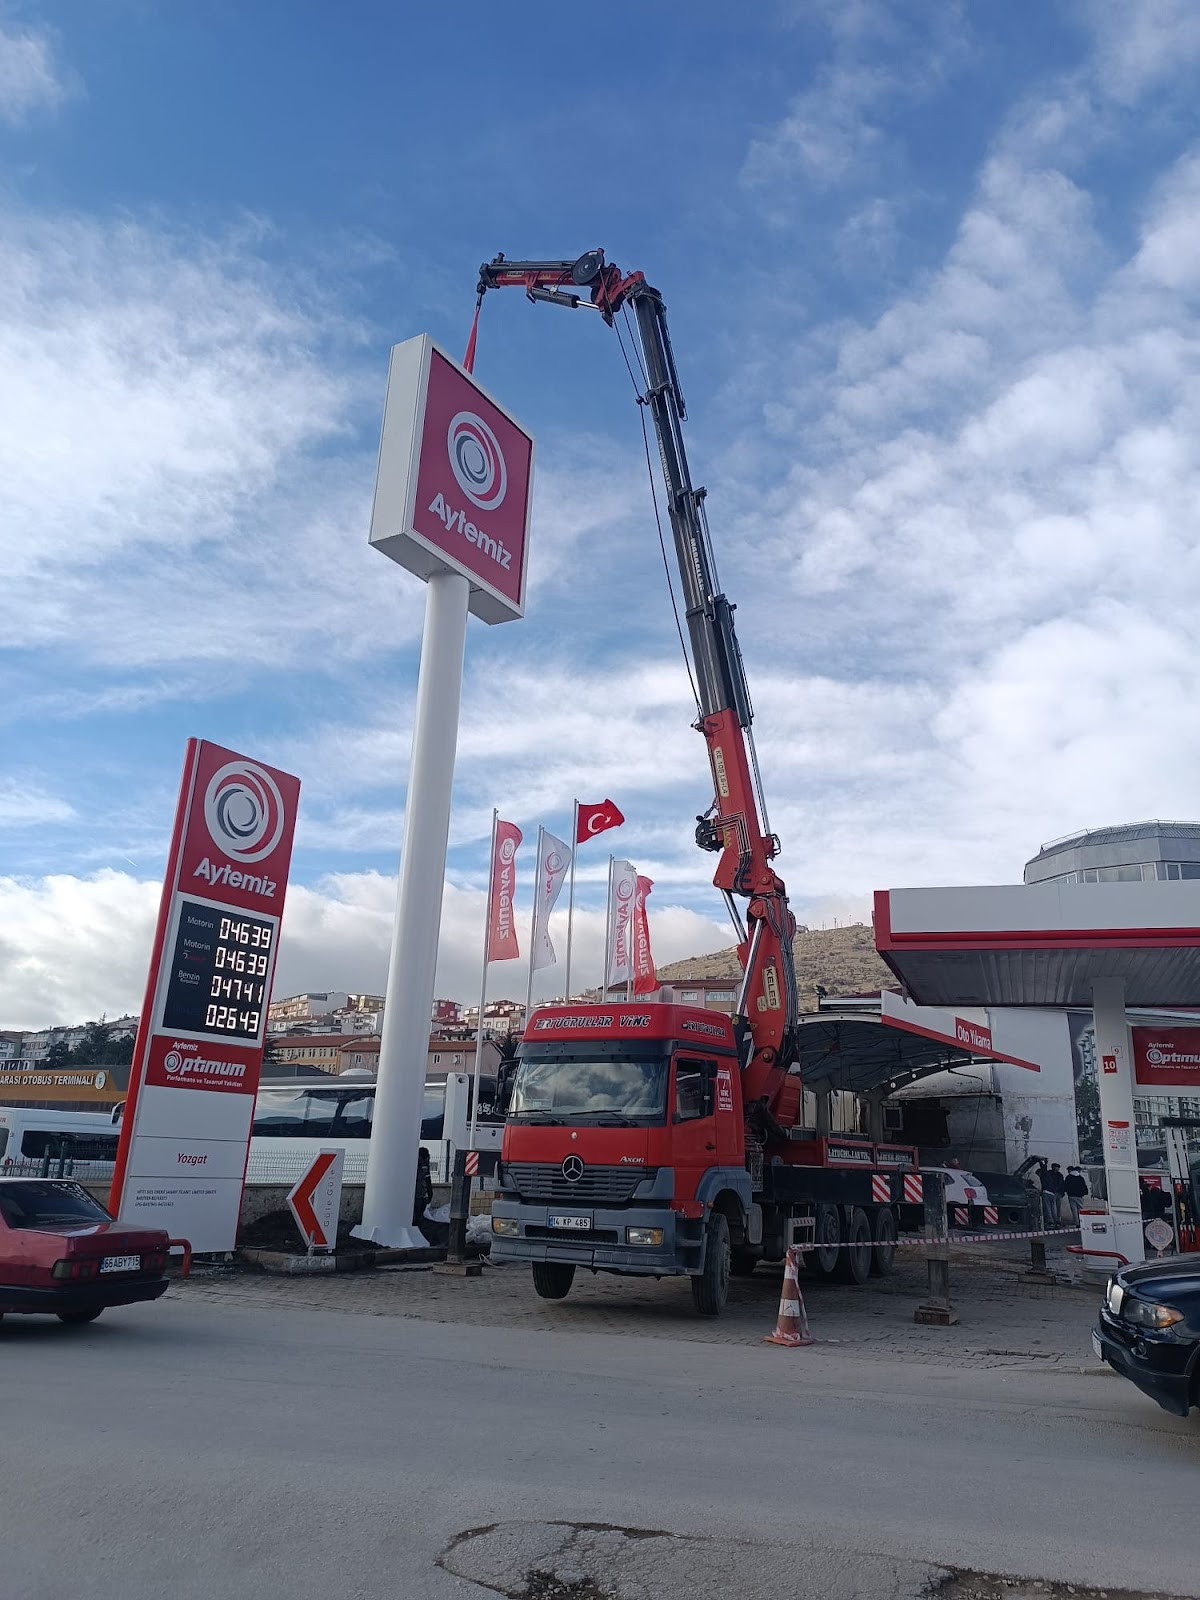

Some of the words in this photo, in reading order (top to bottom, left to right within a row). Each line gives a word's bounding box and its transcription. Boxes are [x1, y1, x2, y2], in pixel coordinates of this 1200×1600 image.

[428, 492, 512, 570] Aytemiz
[193, 857, 277, 898] Aytemiz
[187, 916, 214, 929] Motorin
[219, 918, 271, 949] 04639
[184, 939, 211, 951] Motorin
[215, 947, 267, 976] 04639
[178, 970, 200, 981] Benzin
[211, 975, 263, 1003] 04741
[205, 1004, 259, 1032] 02643
[172, 1041, 198, 1051] Aytemiz
[957, 1025, 970, 1043] Oto
[1104, 1061, 1115, 1070] 10
[177, 1152, 208, 1167] Yozgat
[553, 1217, 560, 1226] 14
[562, 1218, 572, 1226] KP
